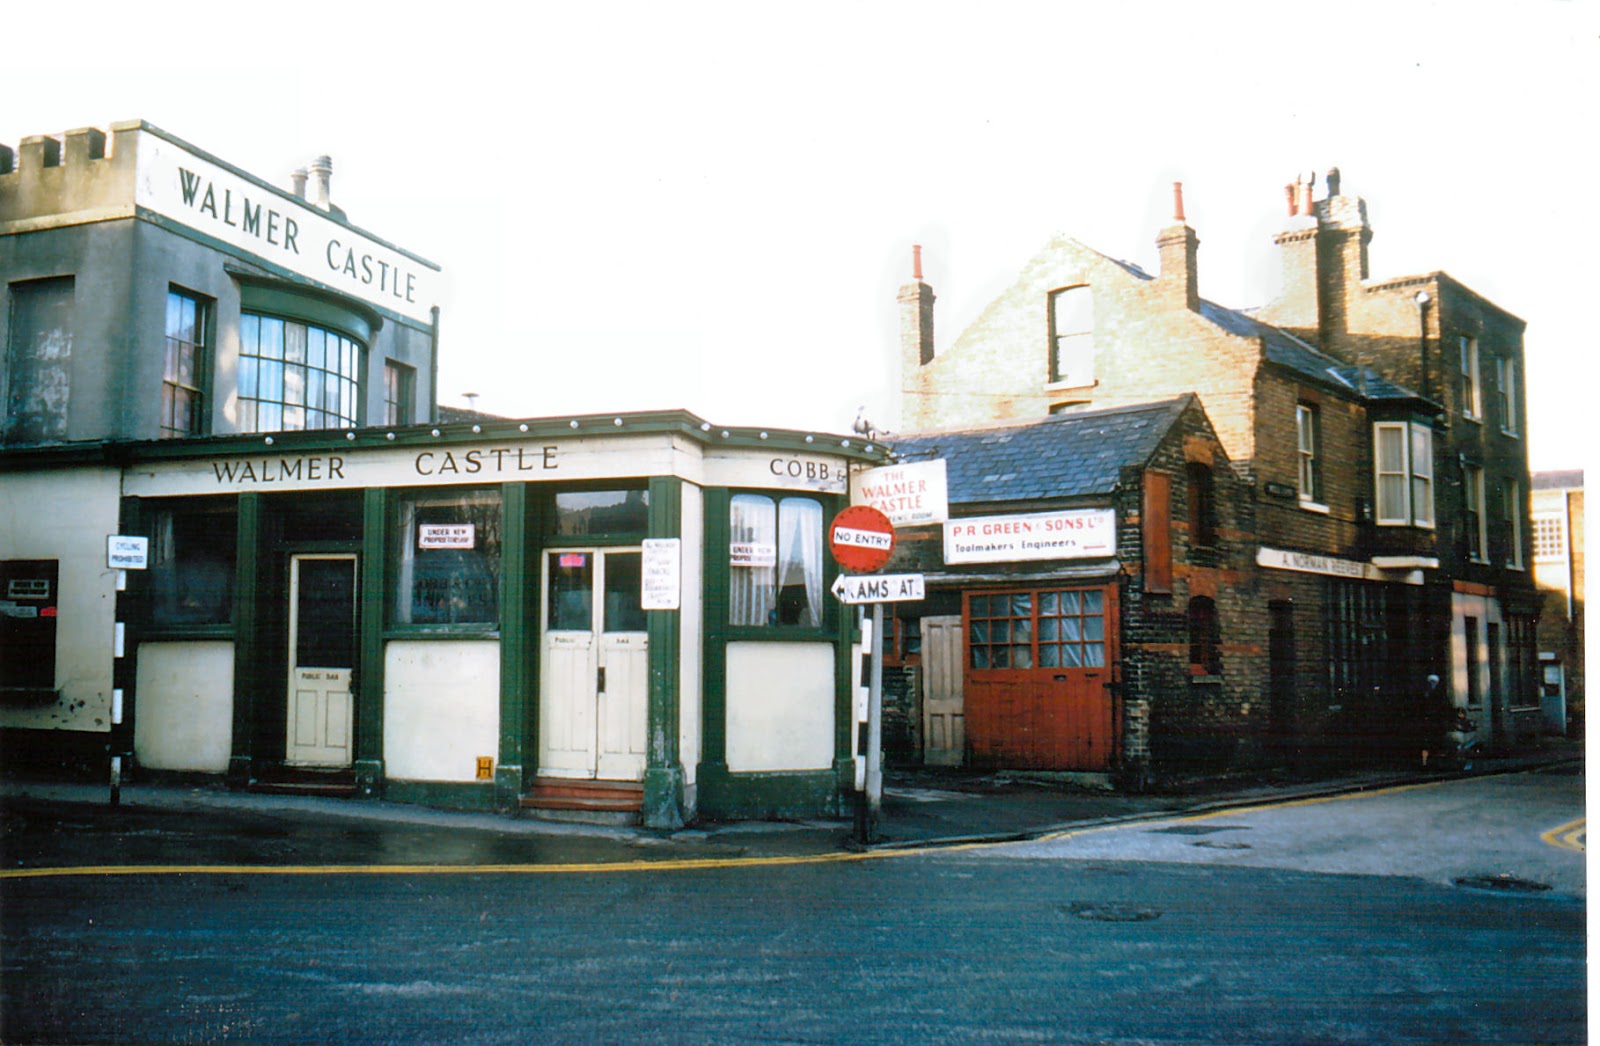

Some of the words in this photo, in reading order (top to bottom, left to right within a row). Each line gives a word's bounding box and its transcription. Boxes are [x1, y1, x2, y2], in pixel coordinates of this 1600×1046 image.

[178, 167, 299, 254] WALMER
[326, 239, 417, 303] CASTLE
[213, 456, 345, 484] WALMER
[414, 445, 559, 476] CASTLE
[769, 458, 829, 480] COBB
[884, 471, 905, 481] THE
[861, 479, 927, 498] WALMER
[869, 495, 922, 512] CASTLE
[952, 526, 962, 537] P
[967, 525, 975, 536] R
[982, 521, 1032, 536] GREEN
[1045, 517, 1083, 531] SONS
[835, 532, 851, 542] NO
[855, 534, 889, 545] ENTRY
[955, 542, 1014, 553] Toolmakers
[1021, 539, 1077, 550] Engineers
[850, 578, 922, 599] AMSAT
[477, 758, 493, 779] H
